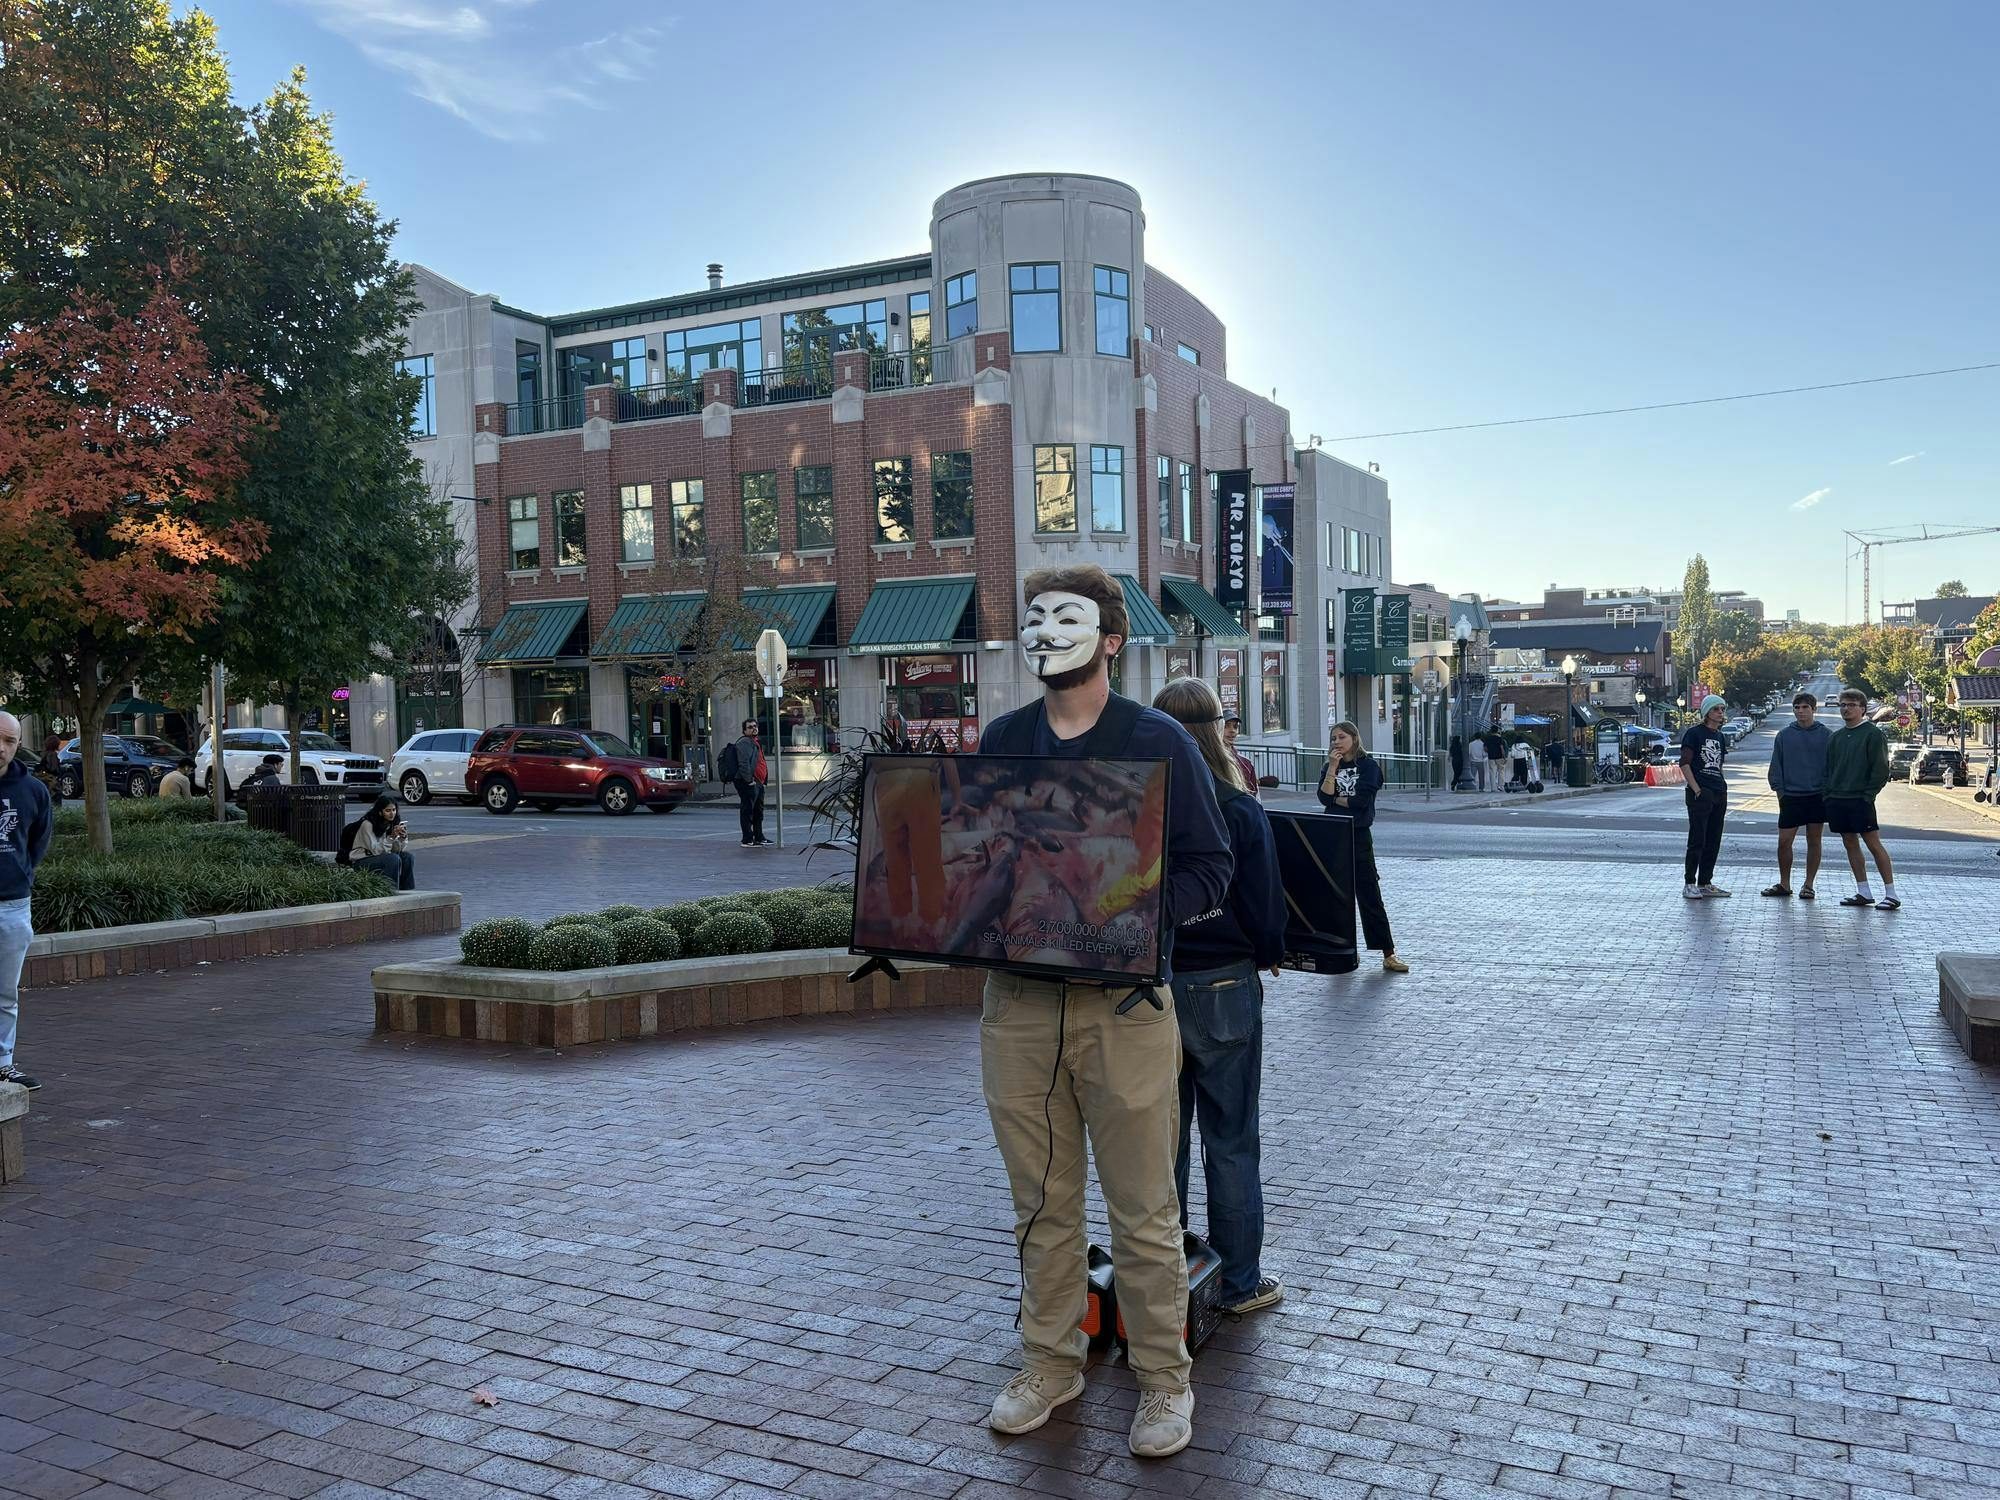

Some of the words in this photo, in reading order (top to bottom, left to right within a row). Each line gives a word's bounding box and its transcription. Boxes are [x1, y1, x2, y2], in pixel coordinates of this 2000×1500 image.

[904, 662, 933, 680] Indiana
[333, 689, 350, 699] OPEN
[1039, 920, 1150, 941] 2,700,000,000,000
[983, 932, 1002, 943] SEA
[1002, 934, 1046, 948] ANIMALS
[1049, 938, 1083, 951] KILLED
[1086, 941, 1119, 954] EVERY
[1121, 944, 1149, 957] YEAR
